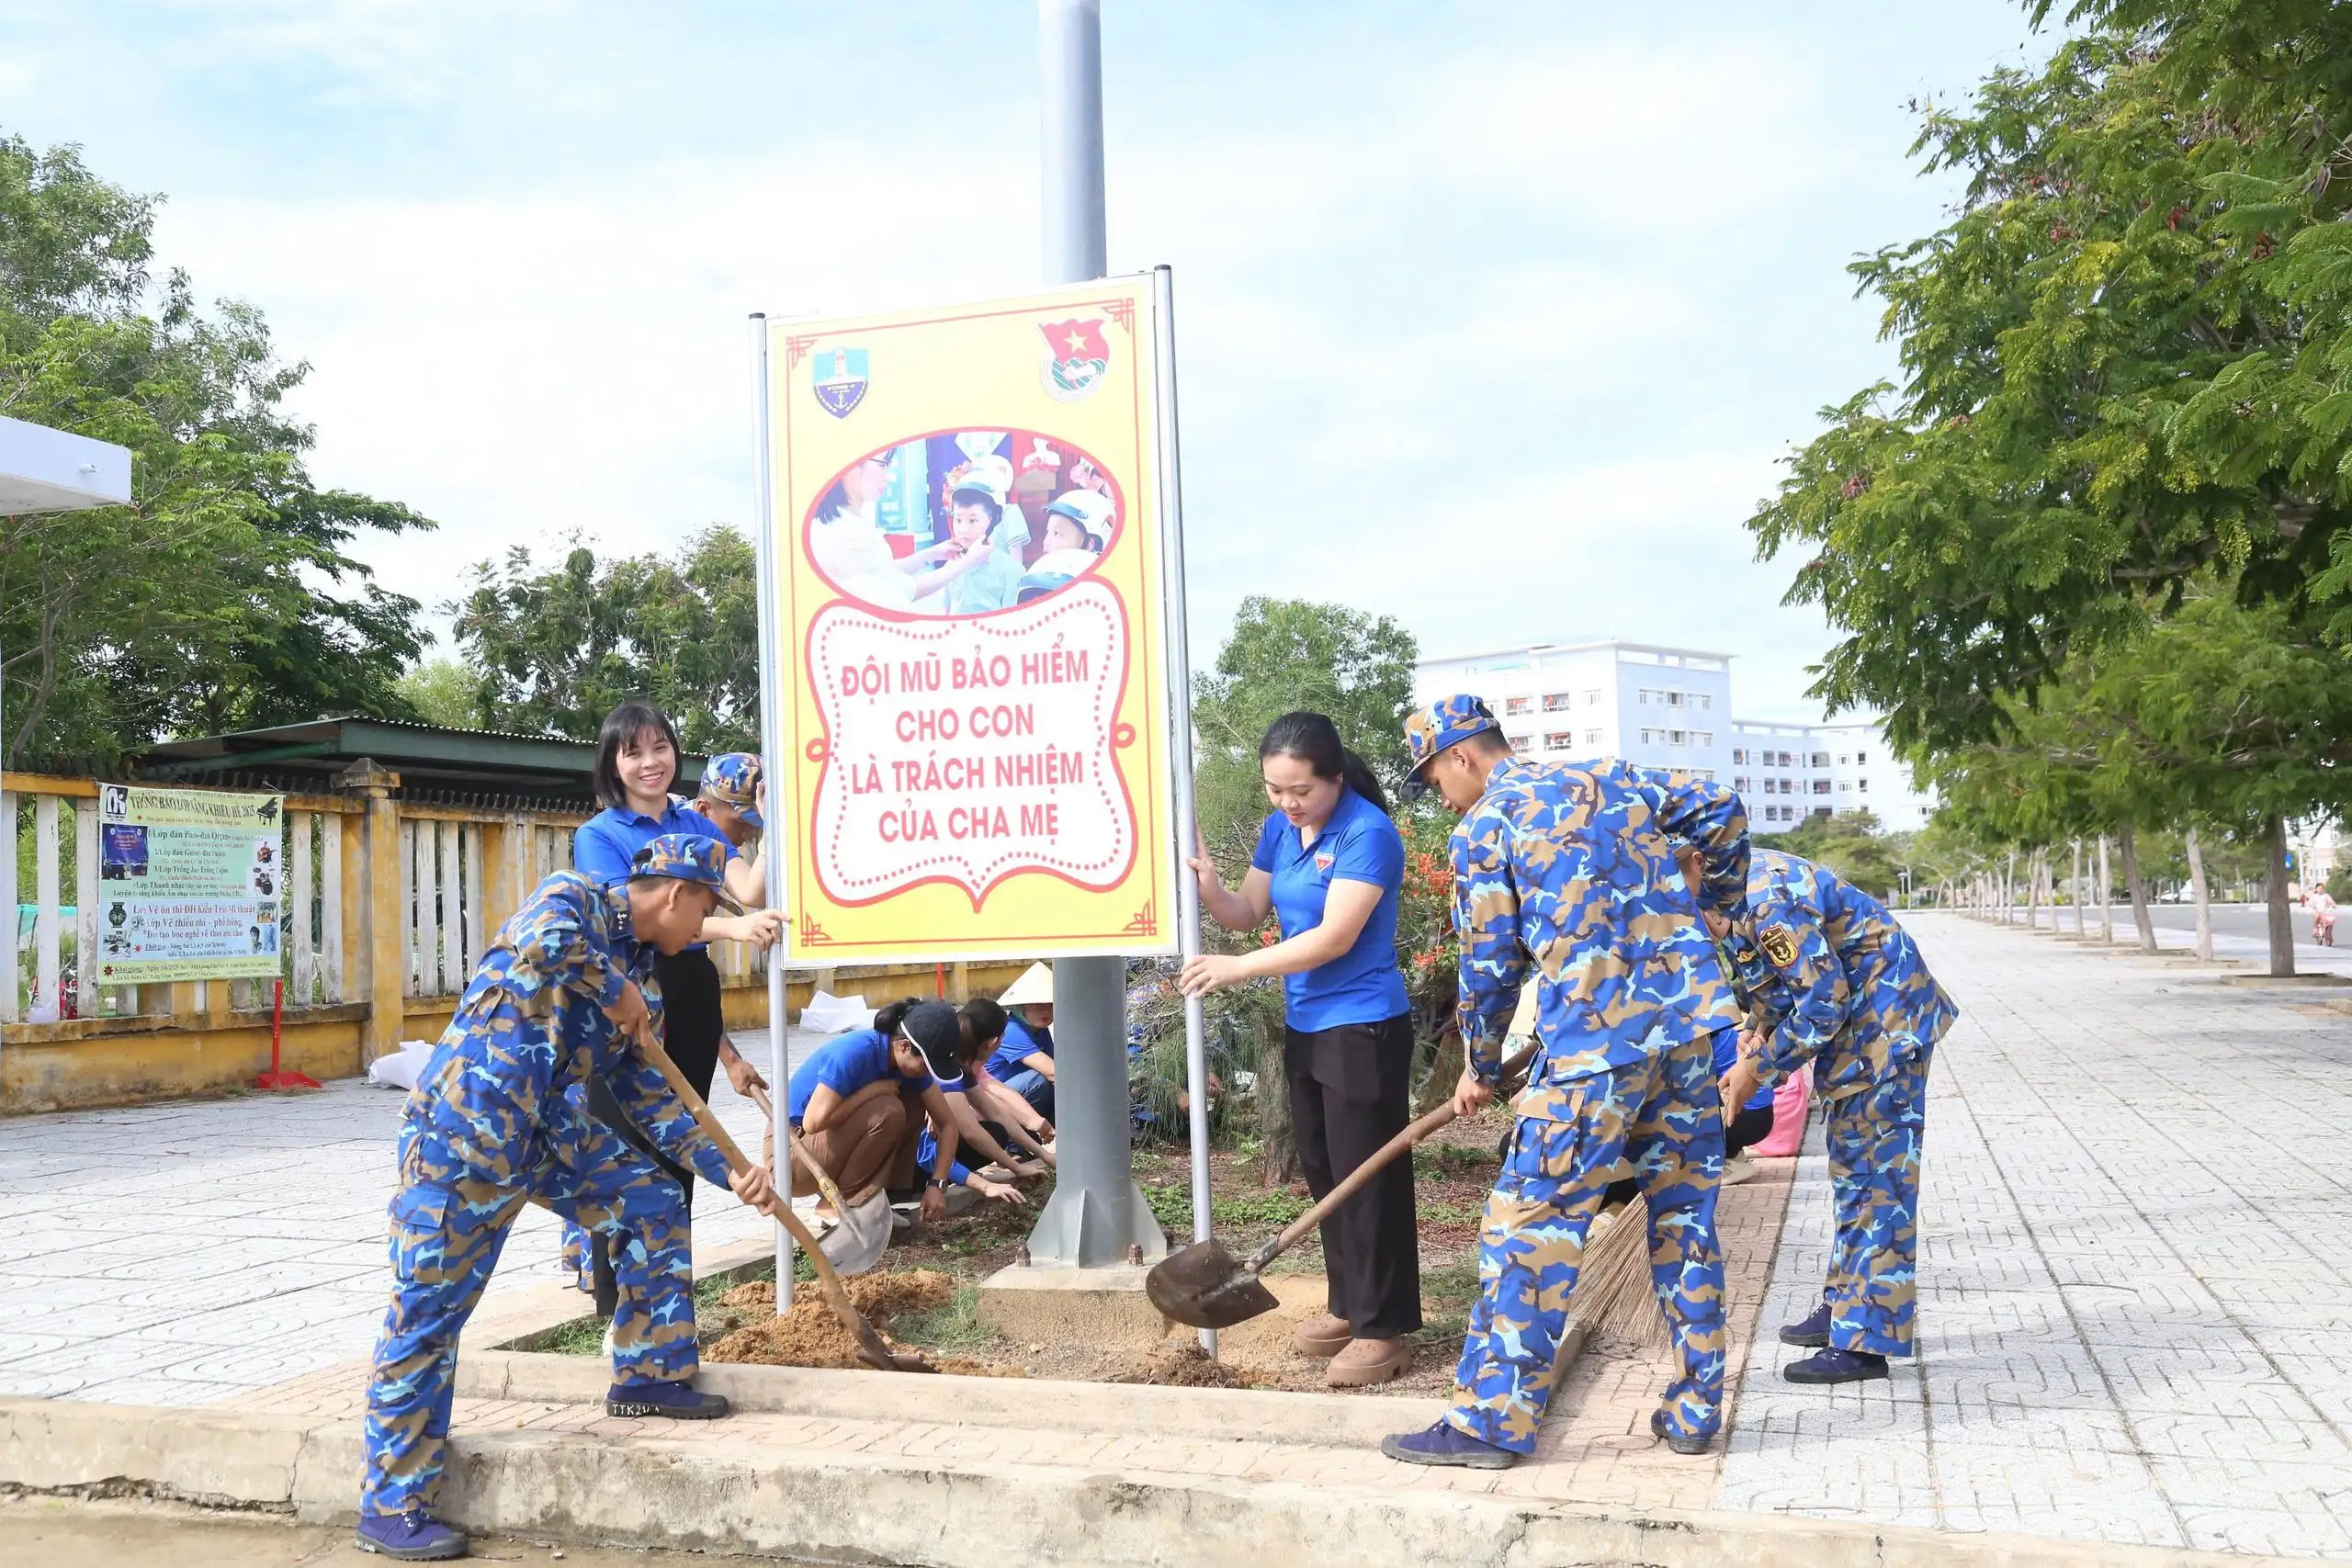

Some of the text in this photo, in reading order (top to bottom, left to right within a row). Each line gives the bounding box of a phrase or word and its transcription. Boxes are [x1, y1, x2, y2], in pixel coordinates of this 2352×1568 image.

[841, 632, 1089, 705] ĐỘI MŨ BẢO HIỂM
[895, 703, 1035, 743] CHO CON
[852, 743, 1083, 795] LÀ TRÁCH NHIỆM
[878, 797, 1058, 846] CỦA CHA MẸ
